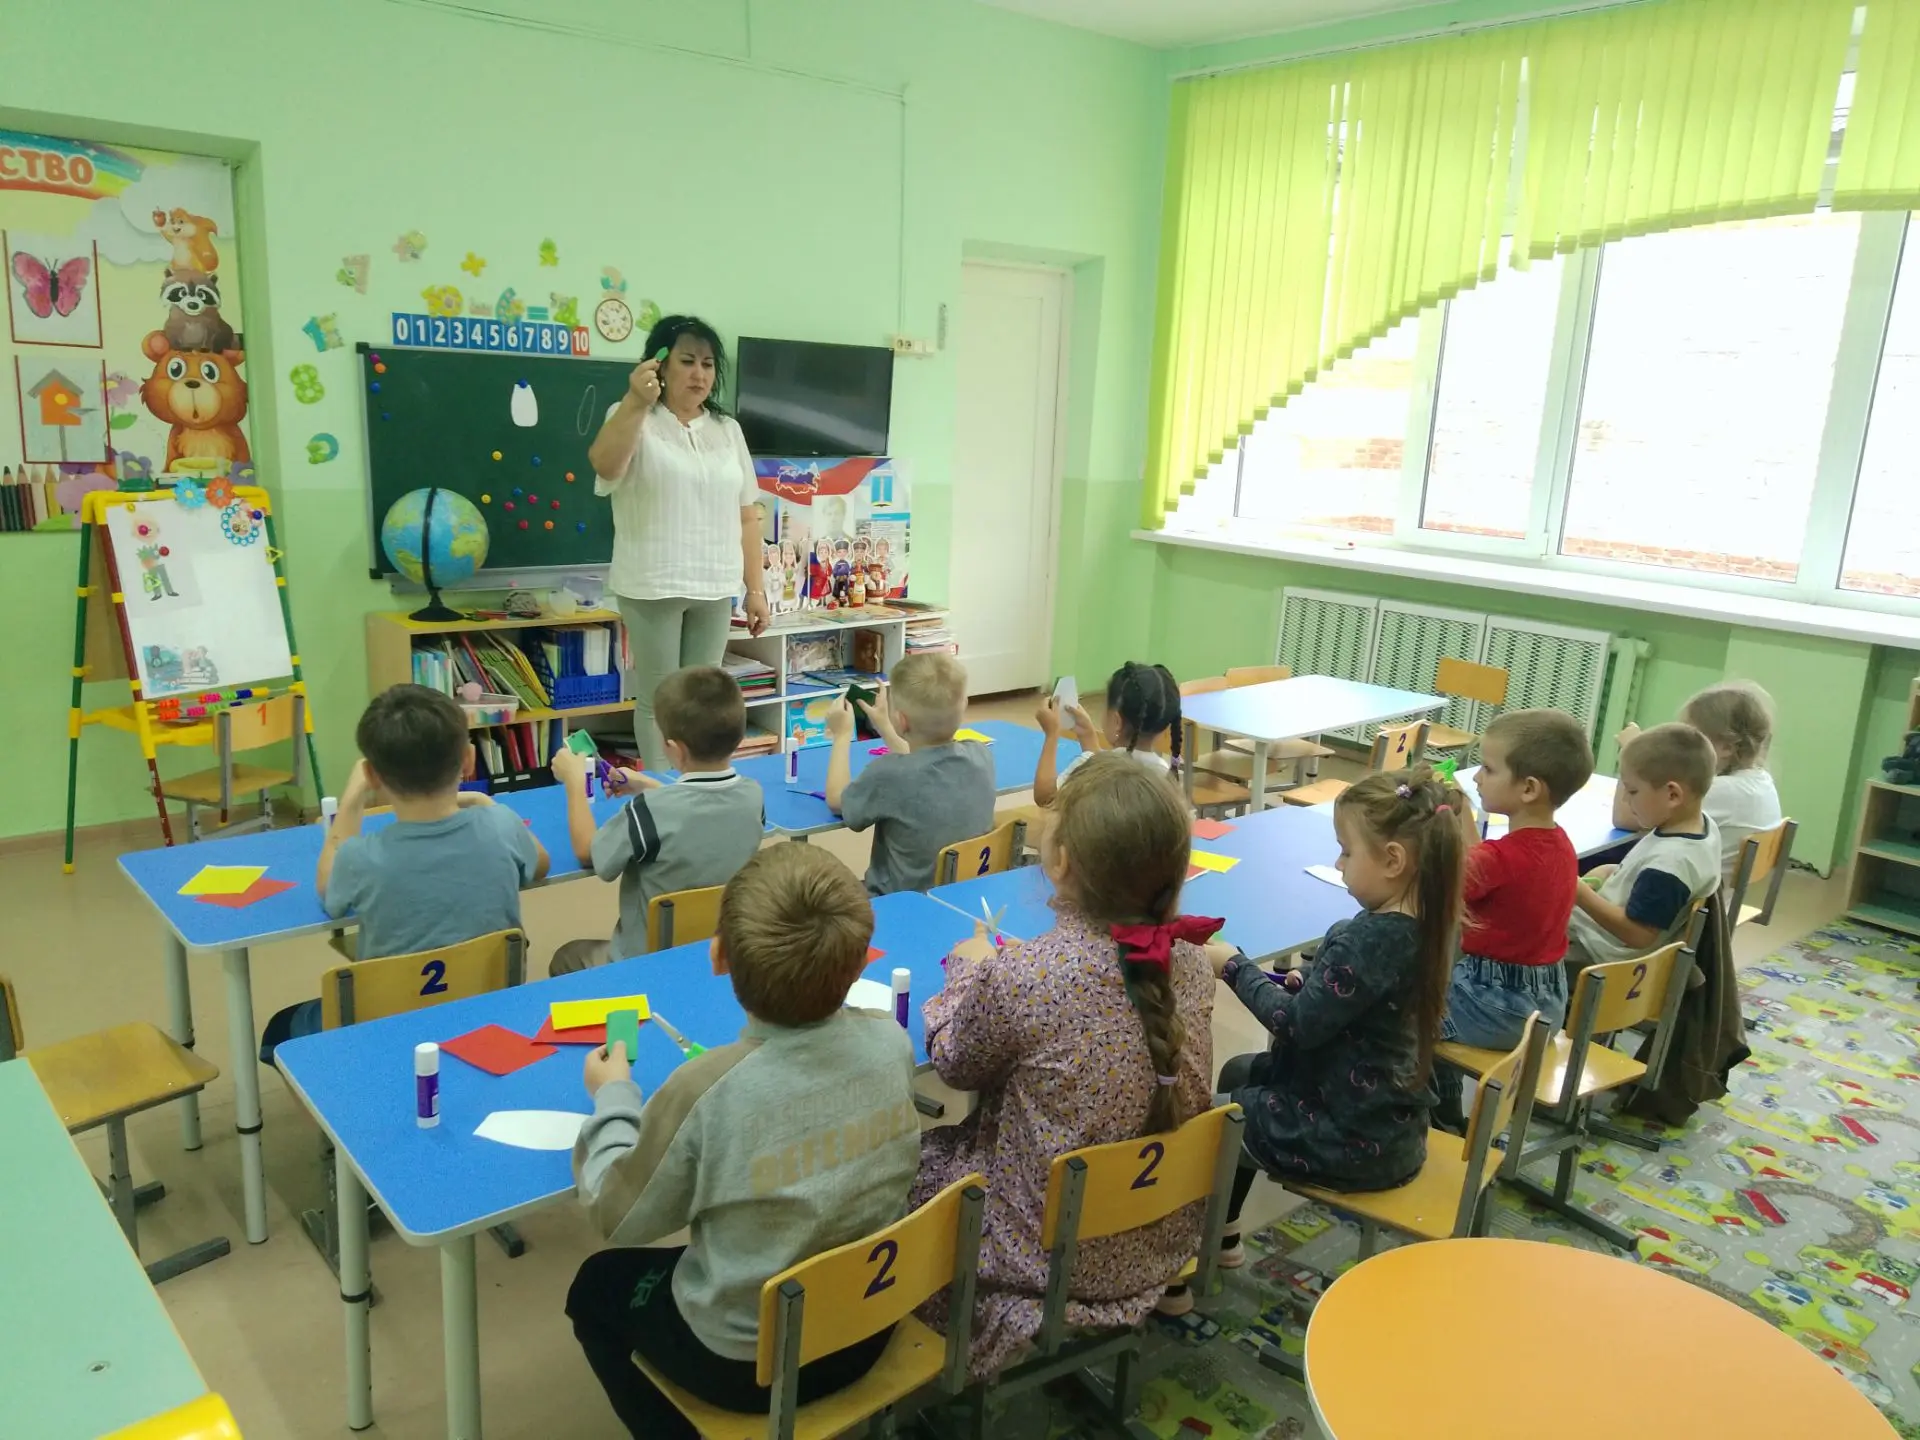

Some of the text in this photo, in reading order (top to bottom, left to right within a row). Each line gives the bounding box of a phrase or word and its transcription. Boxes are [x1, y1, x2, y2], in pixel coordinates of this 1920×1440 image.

[0, 146, 94, 186] СТВО
[396, 318, 589, 352] 0 1 2 3 4 5 6 7 8 9 10
[290, 364, 325, 404] 8
[257, 703, 267, 726] 1
[1396, 732, 1407, 753] 2
[977, 846, 990, 876] 2
[420, 960, 448, 996] 2
[1625, 963, 1647, 1001] 2
[1130, 1141, 1165, 1190] 2
[863, 1240, 898, 1300] 2
